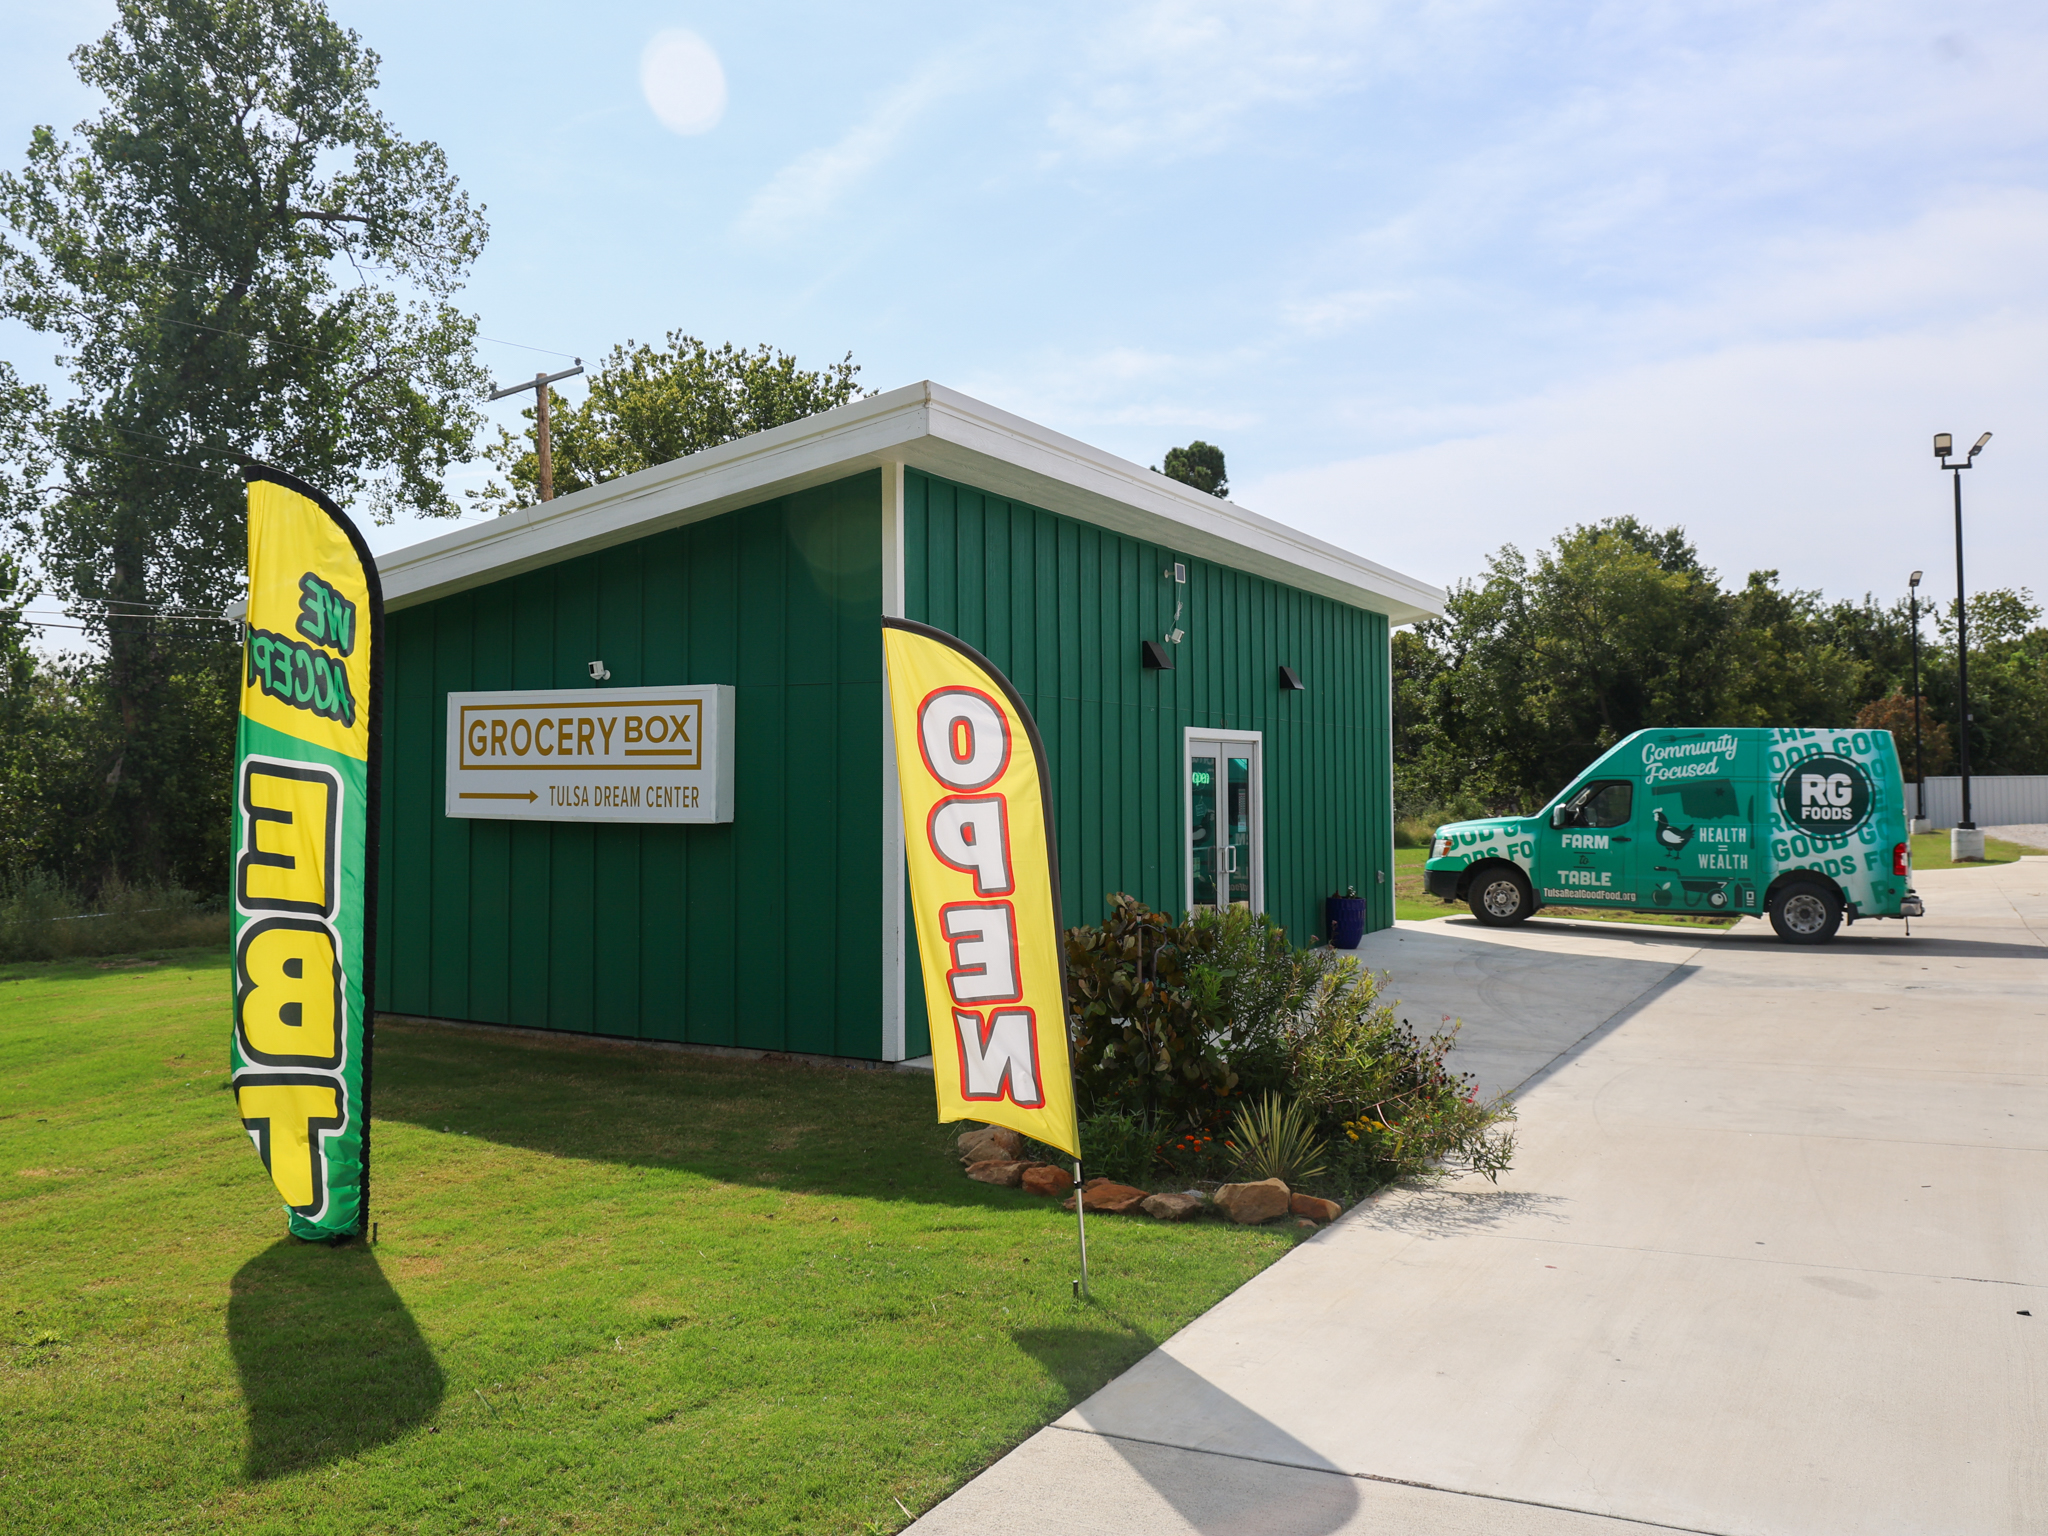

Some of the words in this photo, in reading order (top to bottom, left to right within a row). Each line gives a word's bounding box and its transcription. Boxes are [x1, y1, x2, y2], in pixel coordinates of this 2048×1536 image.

[468, 717, 618, 756] GROCERY
[625, 715, 691, 743] BOX
[1641, 734, 1739, 764] Community
[1645, 756, 1719, 785] Focused
[549, 785, 589, 807] TULSA
[594, 786, 640, 808] DREAM
[646, 786, 699, 808] CENTER
[1801, 773, 1852, 806] RG
[1801, 807, 1853, 820] FOODS
[1562, 834, 1609, 849] FARM
[1699, 827, 1747, 842] HEALTH
[1698, 854, 1748, 869] WEALTH
[1557, 870, 1612, 887] TABLE
[1543, 887, 1637, 902] TulsaRealGoodFood.org
